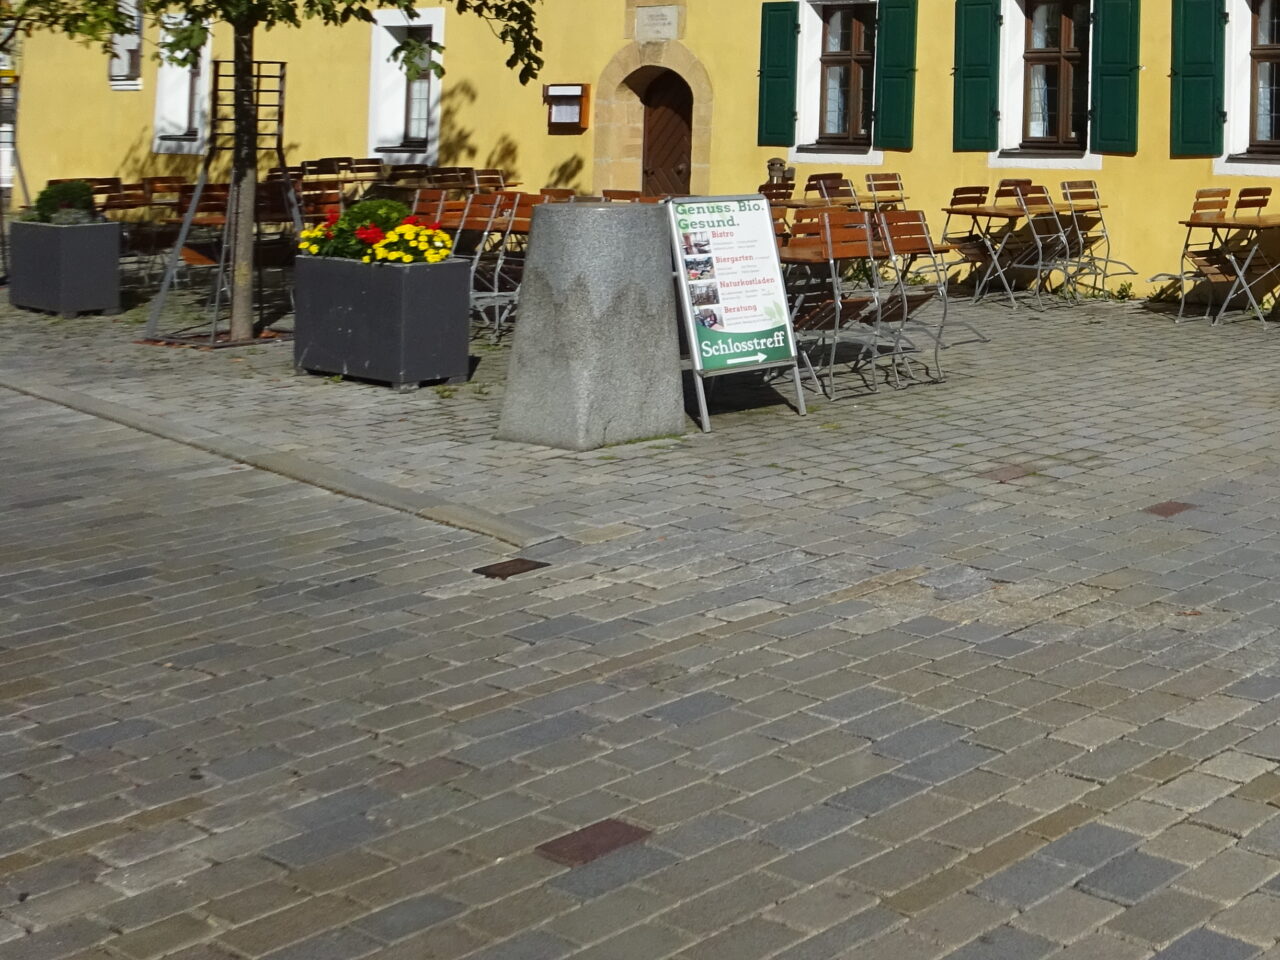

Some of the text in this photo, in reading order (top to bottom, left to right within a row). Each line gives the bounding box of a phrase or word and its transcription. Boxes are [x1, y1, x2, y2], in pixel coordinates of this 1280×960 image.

[675, 201, 764, 215] Genuss. Bio.
[678, 216, 740, 229] Gesund.
[711, 230, 734, 238] Bistro
[715, 254, 754, 264] Biergarten
[719, 276, 775, 288] Naturkostladen
[723, 304, 757, 314] Beratung
[701, 331, 785, 357] Schlosstreff
